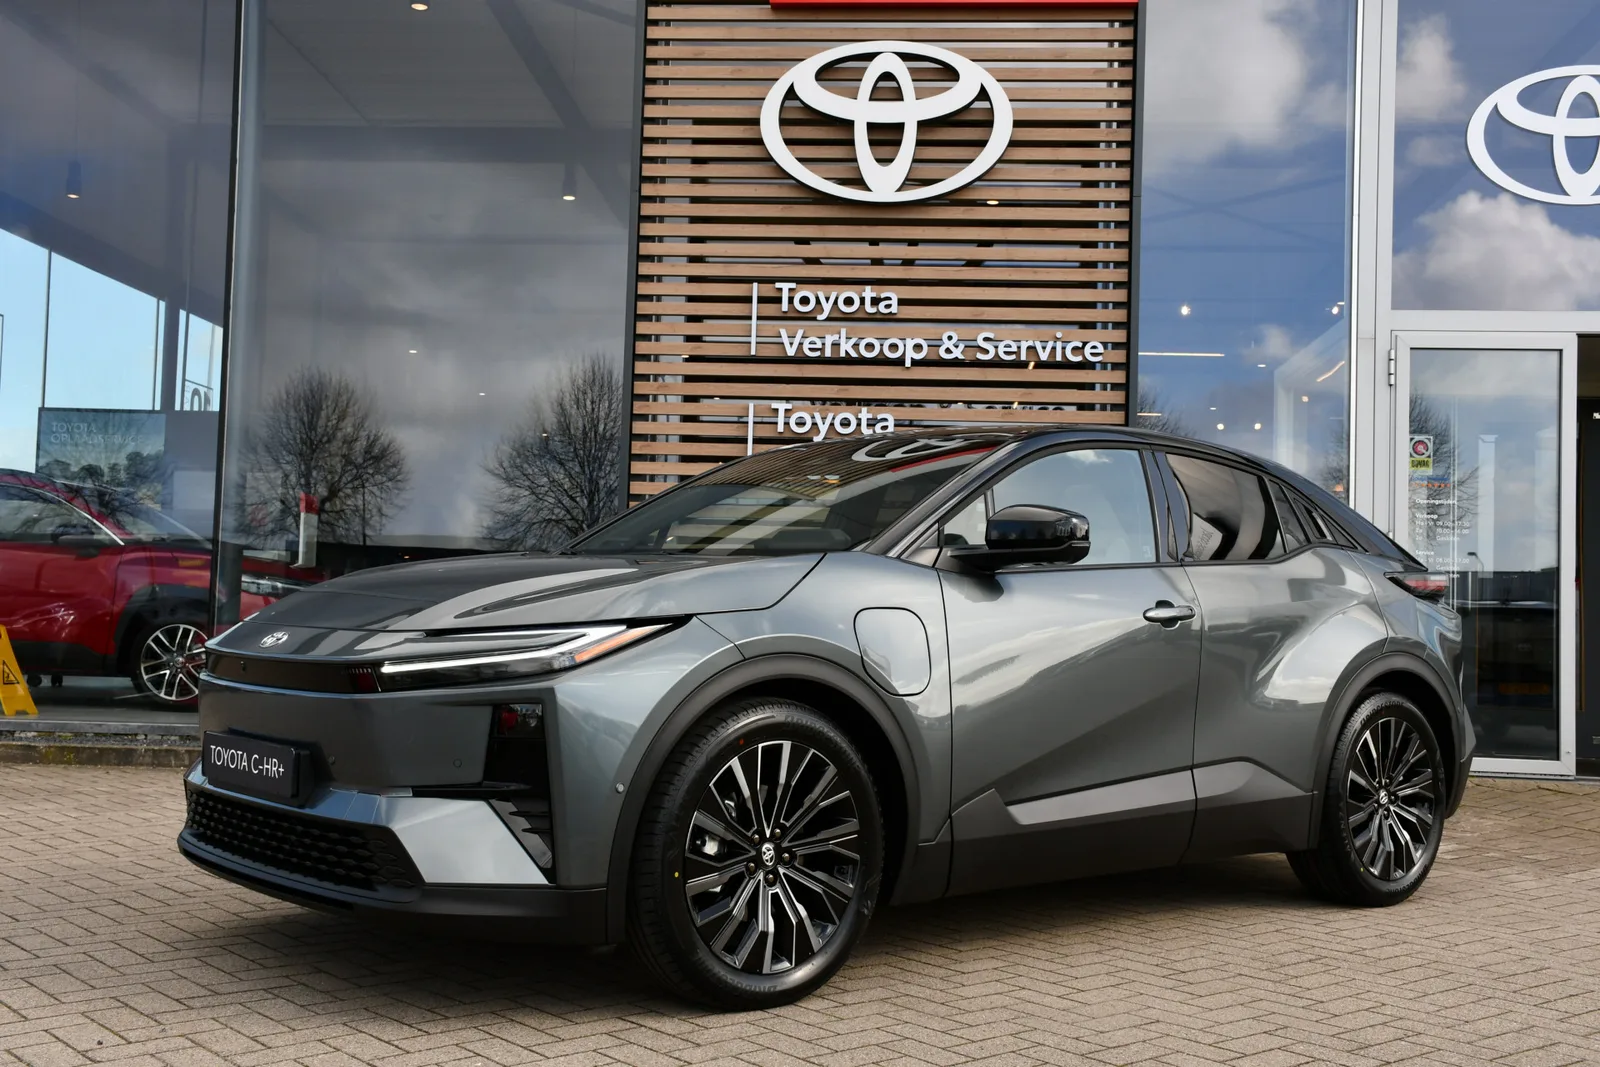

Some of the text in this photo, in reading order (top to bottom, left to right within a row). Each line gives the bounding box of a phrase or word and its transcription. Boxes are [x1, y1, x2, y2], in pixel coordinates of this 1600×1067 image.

[775, 282, 899, 320] Toyota
[779, 328, 1104, 368] Verkoop & Service
[52, 421, 97, 433] TOYOTA
[771, 403, 895, 442] Toyota
[210, 744, 285, 779] TOYOTA C-HR+
